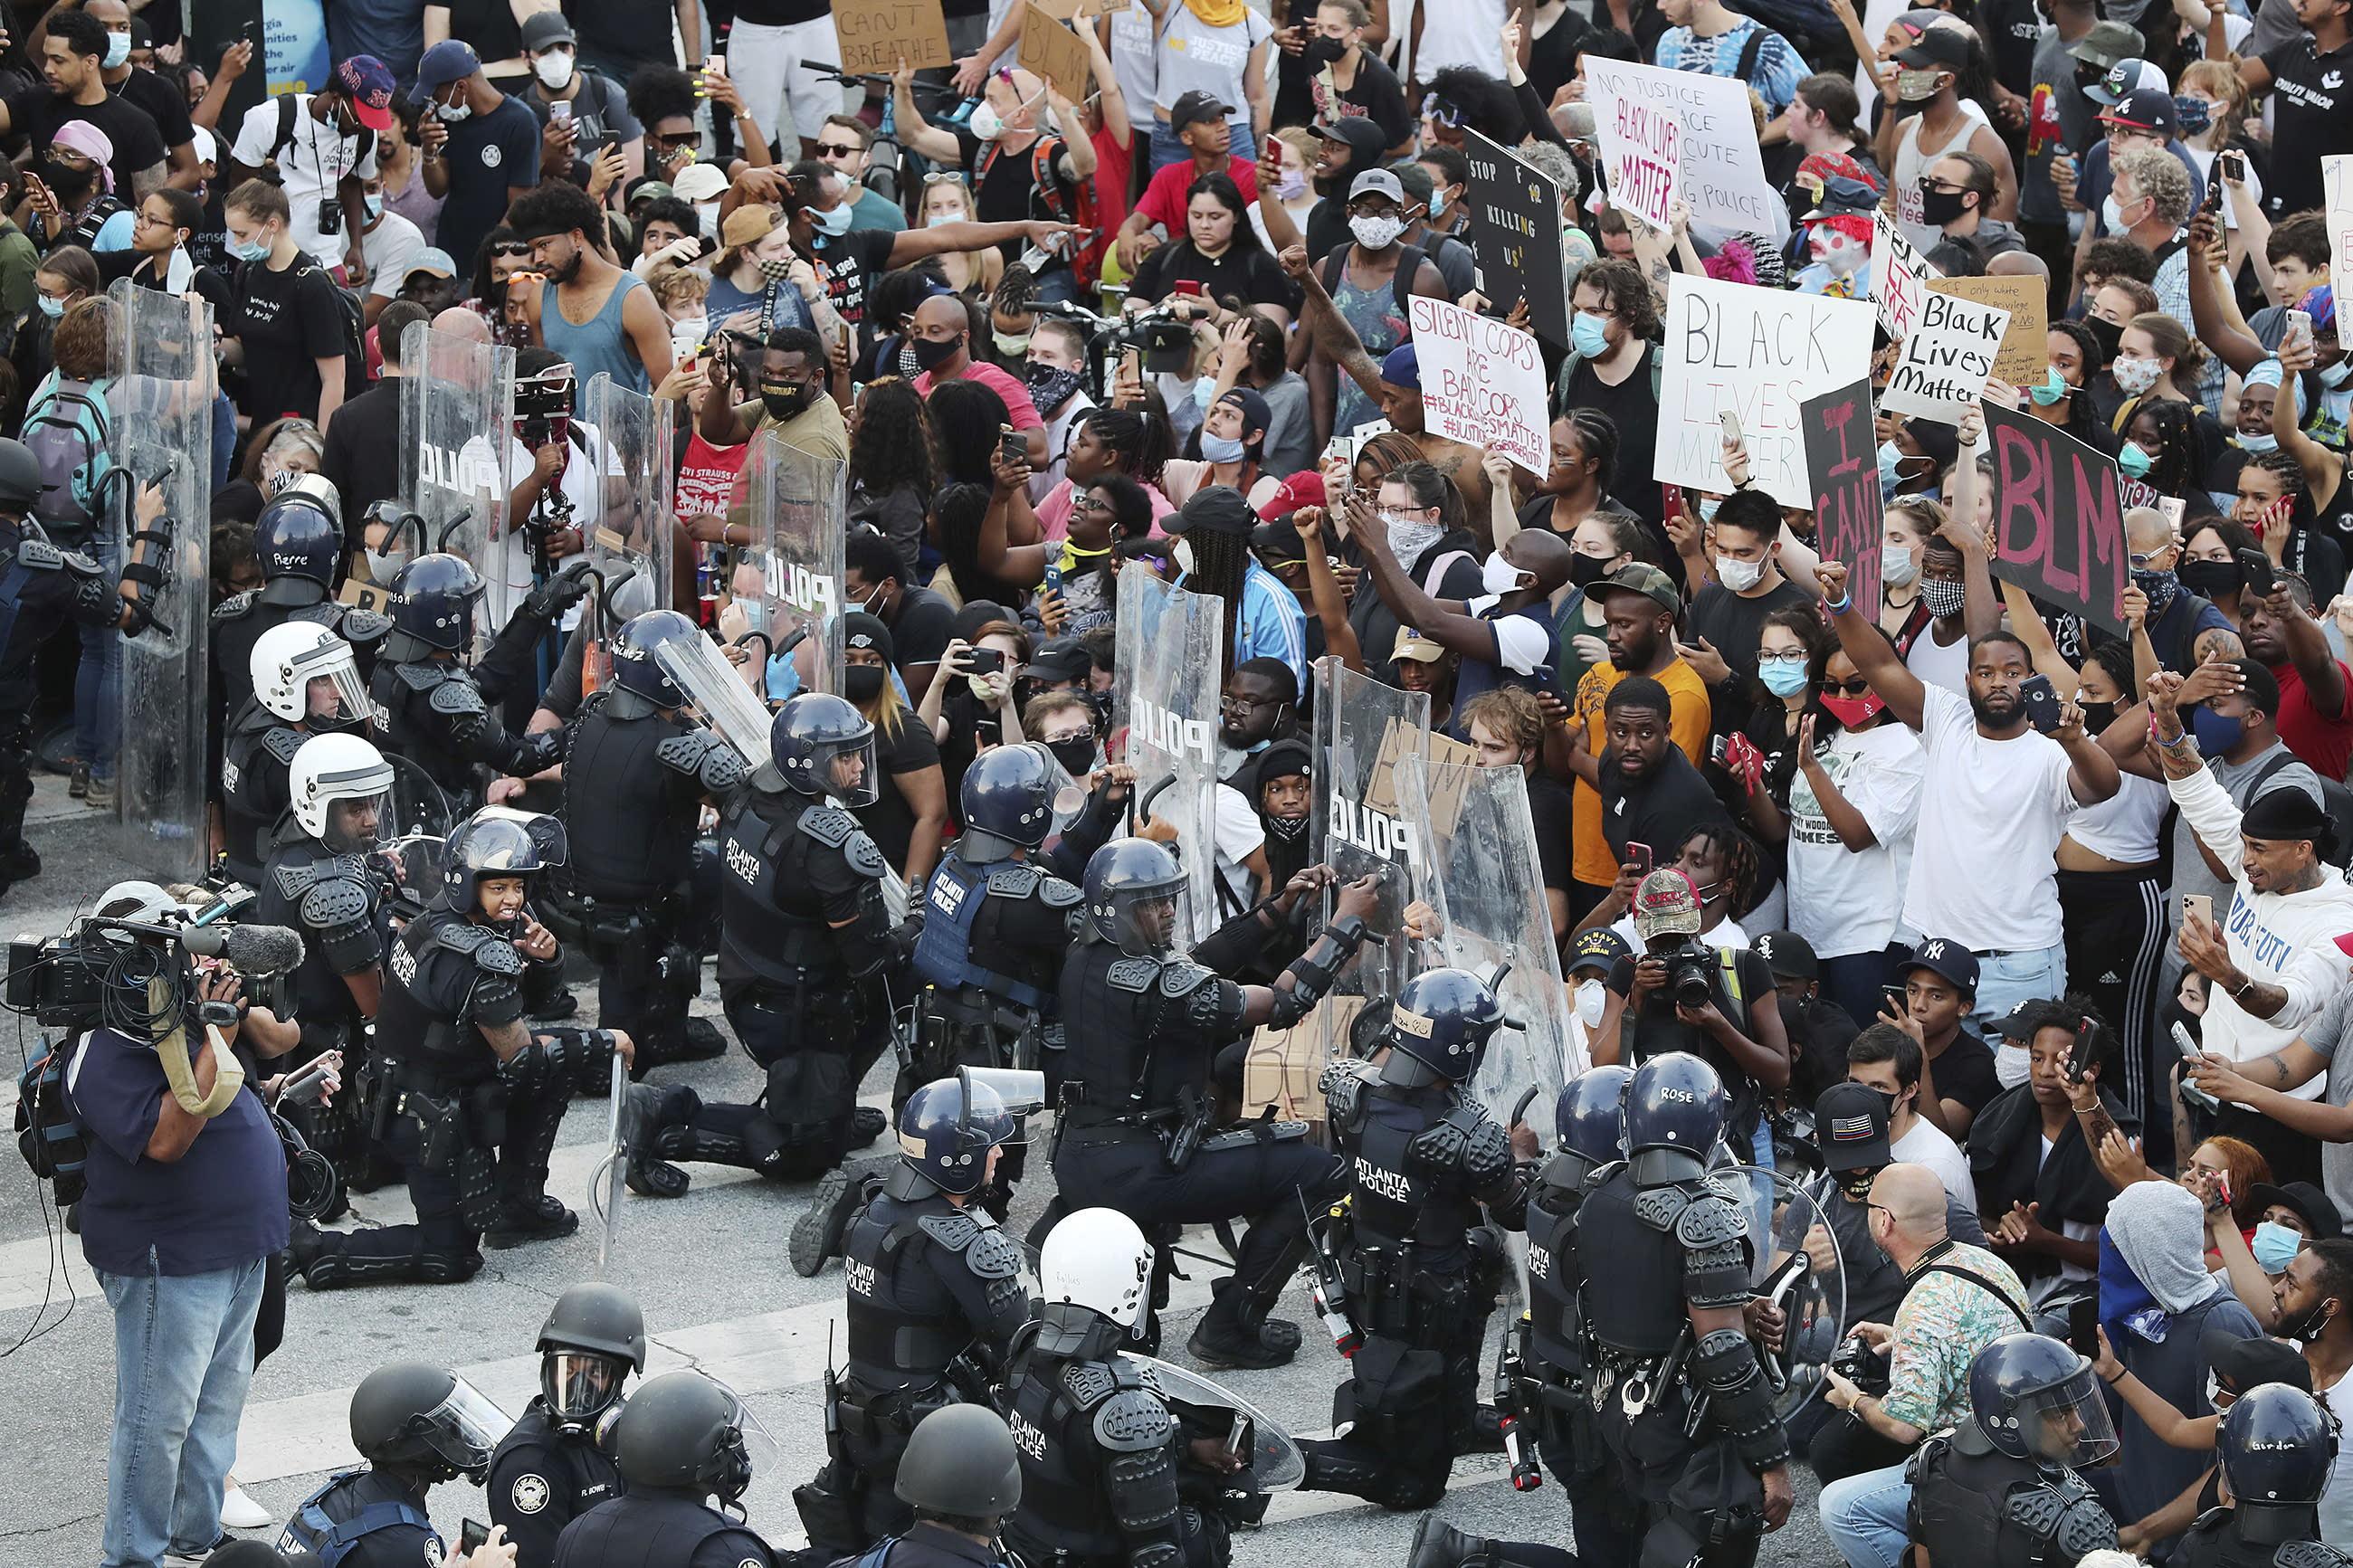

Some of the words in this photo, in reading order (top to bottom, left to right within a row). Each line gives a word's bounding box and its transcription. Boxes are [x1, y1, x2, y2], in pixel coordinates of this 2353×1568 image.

[843, 38, 941, 69] BREATHE
[1021, 10, 1083, 106] BLM
[1167, 36, 1186, 51] NO
[1191, 35, 1249, 57] JUSTICE
[1190, 48, 1238, 67] PEACE
[280, 63, 296, 72] air
[1632, 76, 1706, 107] JUSTICE
[2304, 89, 2335, 110] VALOR
[1617, 98, 1649, 148] BLACK
[1653, 111, 1680, 165] LIVES
[1470, 159, 1496, 182] STOP
[1617, 154, 1672, 224] MATTER
[1703, 184, 1761, 220] POLICE
[1486, 204, 1536, 238] KILLING
[835, 255, 858, 277] get
[847, 274, 861, 289] or
[846, 289, 862, 306] get
[1941, 281, 1962, 294] If
[1970, 282, 1989, 299] only
[1994, 285, 2020, 297] white
[761, 299, 773, 328] GUESS
[1923, 295, 2003, 341] Black
[2019, 315, 2034, 326] NO
[1414, 299, 1479, 347] SILENT
[1485, 323, 1534, 371] COPS
[1684, 293, 1832, 374] BLACK
[1467, 347, 1491, 385] ARE
[1909, 334, 1991, 376] Lives
[1443, 369, 1477, 406] BAD
[1479, 388, 1524, 424] COPS
[1893, 366, 1978, 402] Matter
[1684, 378, 1804, 431] LIVES
[1823, 398, 1862, 477] I
[696, 469, 731, 480] STRAUSS
[1996, 424, 2125, 622] BLM
[727, 837, 760, 876] ATLANTA
[727, 850, 756, 886] POLICE
[931, 887, 957, 916] POLICE
[935, 871, 966, 905] ATLANTA
[1645, 890, 1681, 904] WKU
[1581, 947, 1610, 956] VETERAN
[1592, 932, 1618, 946] NAVY
[390, 952, 412, 988] POLICE
[394, 939, 417, 979] ATLANTA
[1661, 1087, 1693, 1103] ROSE
[1355, 1156, 1411, 1192] ATLANTA
[1358, 1171, 1407, 1202] POLICE
[845, 1255, 875, 1285] ATLANTA
[1528, 1255, 1547, 1279] LICE
[1910, 1255, 1929, 1272] Nikon
[846, 1269, 872, 1297] POLICE
[1009, 1408, 1047, 1450] ATLANTA
[1010, 1423, 1043, 1462] POLICE
